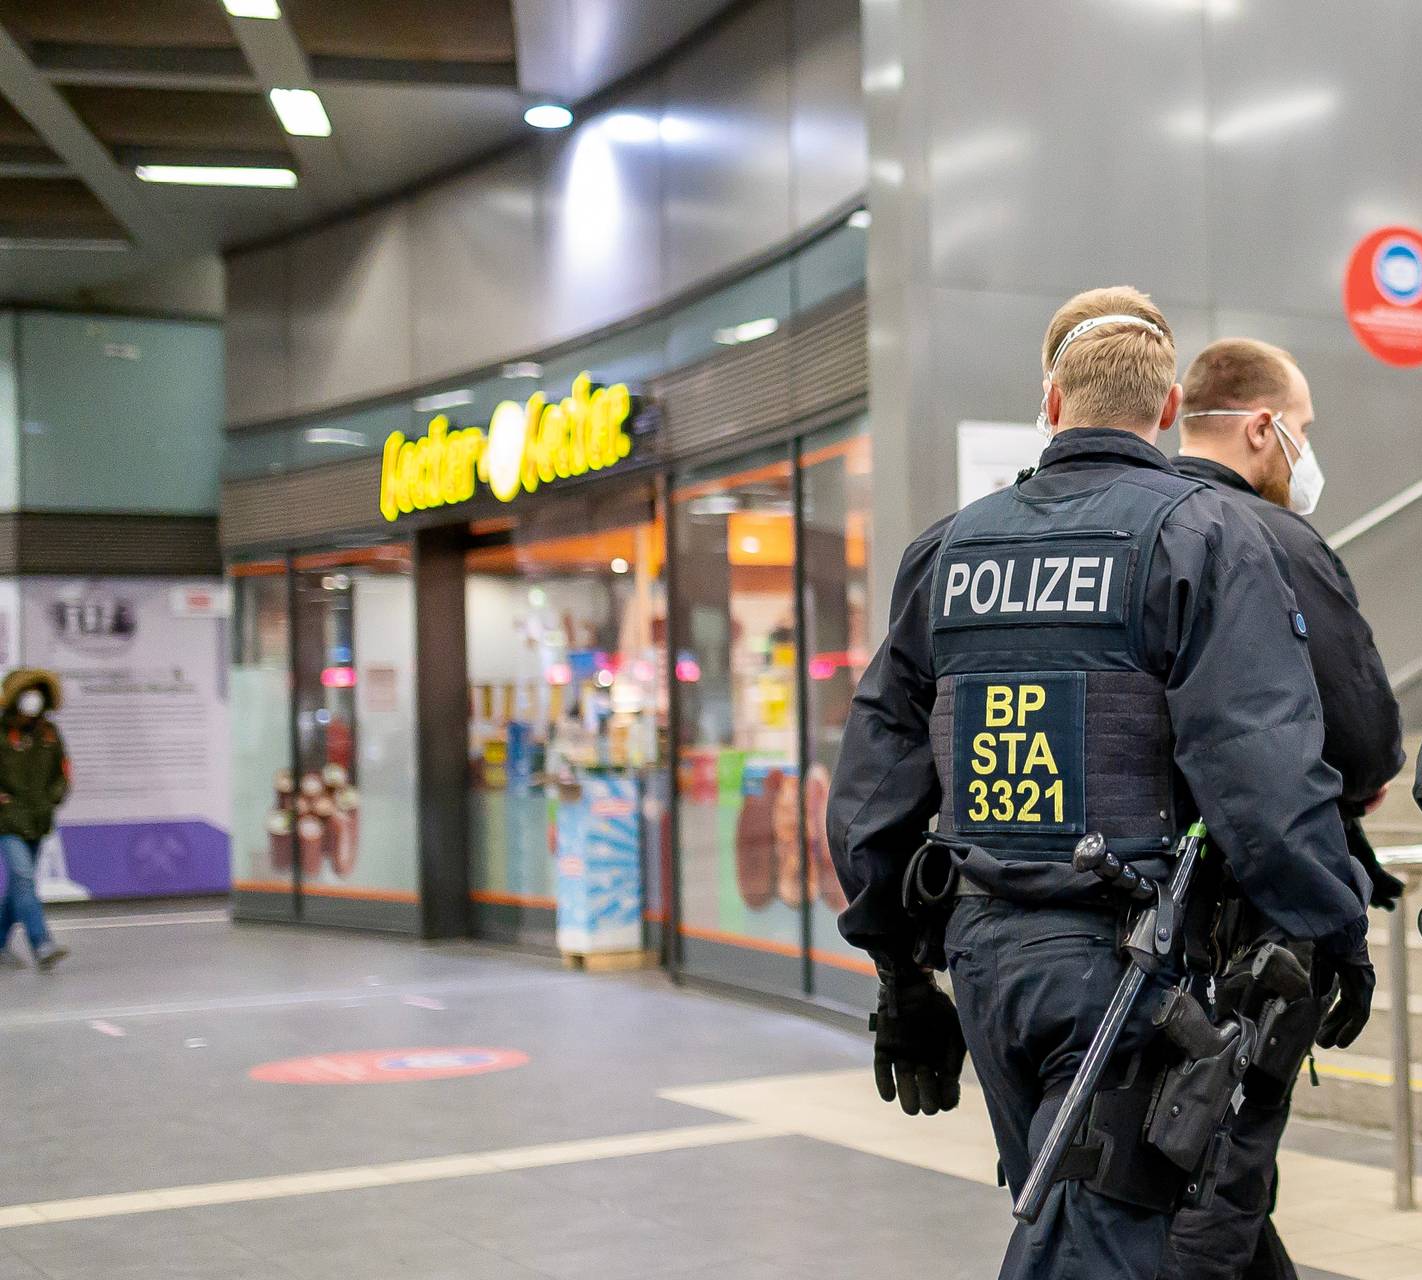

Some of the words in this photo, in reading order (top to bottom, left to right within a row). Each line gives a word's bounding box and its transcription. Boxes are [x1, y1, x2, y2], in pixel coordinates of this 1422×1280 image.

[943, 557, 1114, 616] POLIZEI
[985, 685, 1046, 727] BP
[971, 732, 1058, 774] STA
[968, 780, 1064, 822] 3321
